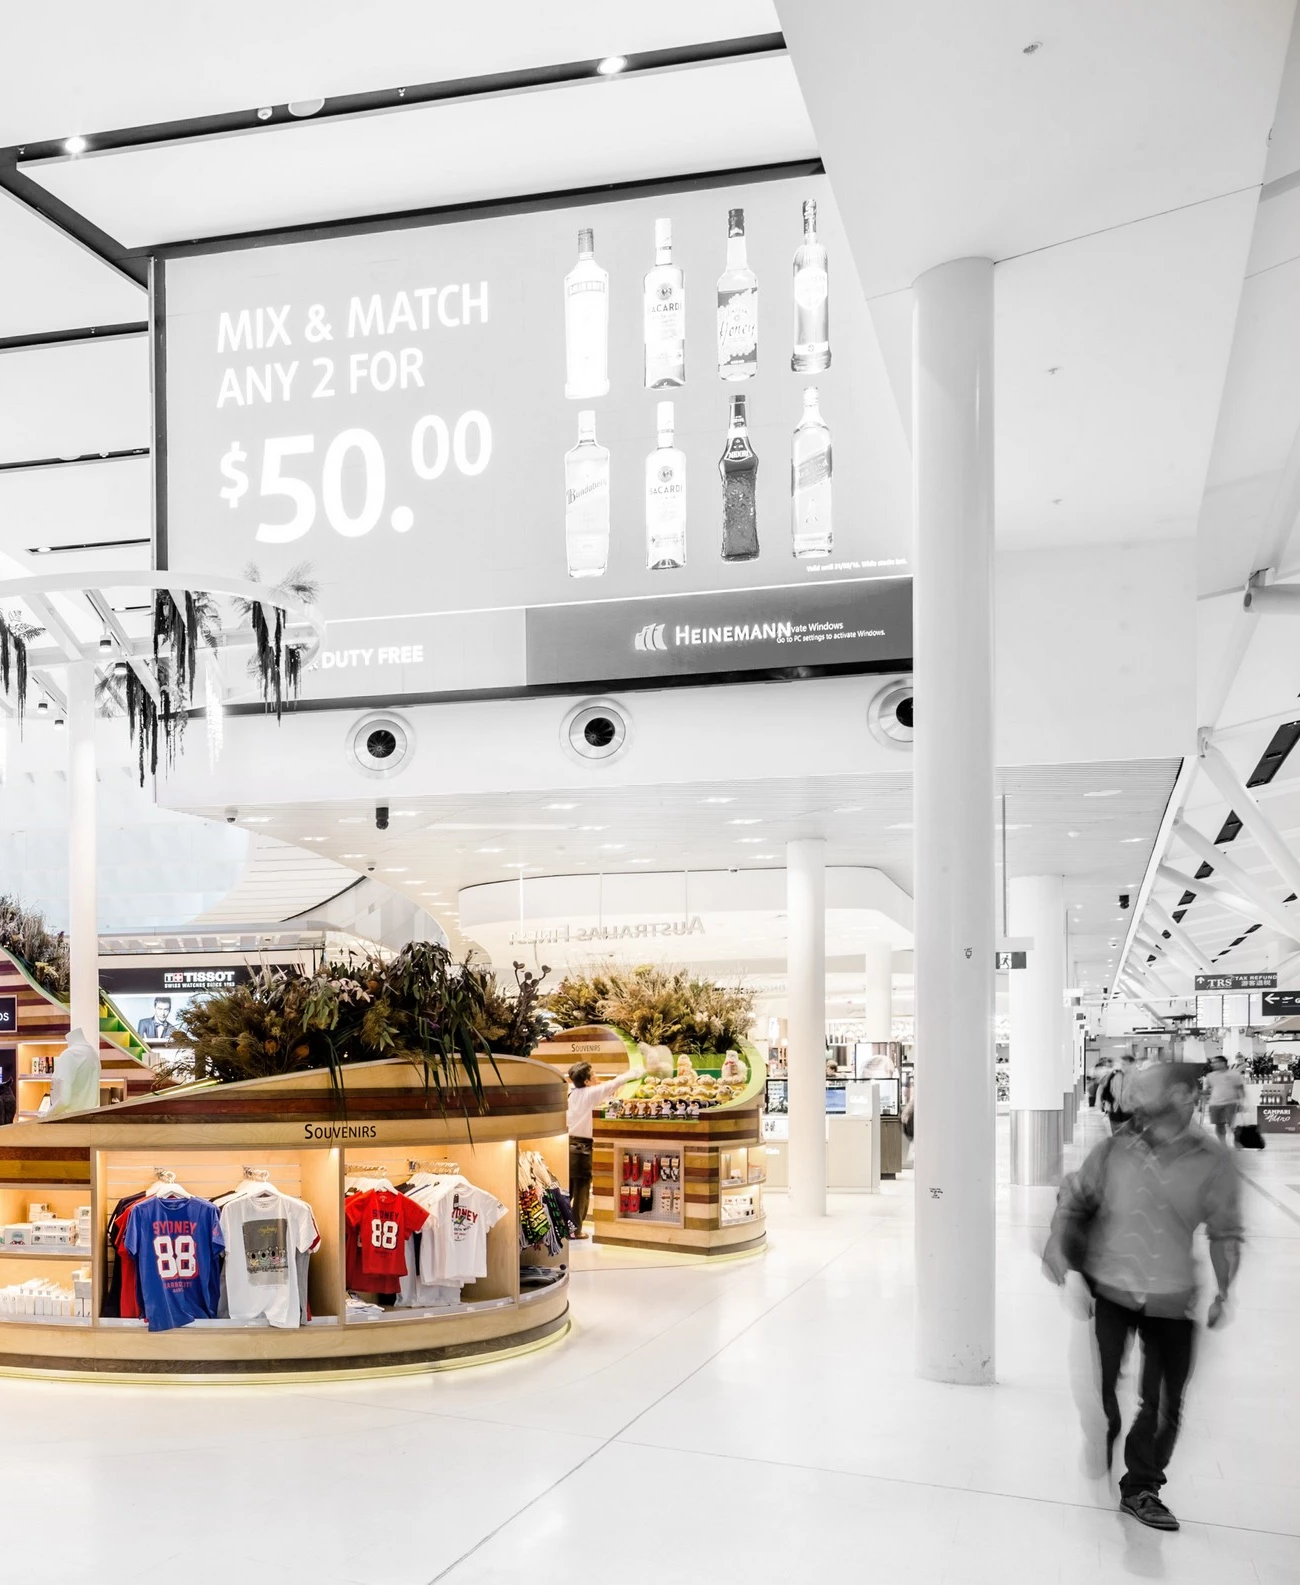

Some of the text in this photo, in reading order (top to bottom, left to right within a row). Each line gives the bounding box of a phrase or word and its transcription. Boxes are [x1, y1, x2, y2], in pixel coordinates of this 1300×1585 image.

[217, 280, 489, 353] MIX & MATCH
[216, 347, 425, 408] ANY 2 FOR
[675, 621, 791, 646] HEINEMANN
[776, 636, 786, 644] Go
[794, 634, 802, 642] PC
[803, 633, 825, 643] settings
[826, 632, 832, 640] to
[833, 631, 856, 640] activate
[808, 621, 844, 631] Windows
[322, 649, 374, 669] DUTY
[378, 645, 424, 664] FREE
[183, 971, 235, 983] TISSOT
[1207, 978, 1232, 988] TRS
[371, 1219, 399, 1251] 88
[153, 1235, 199, 1280] 88
